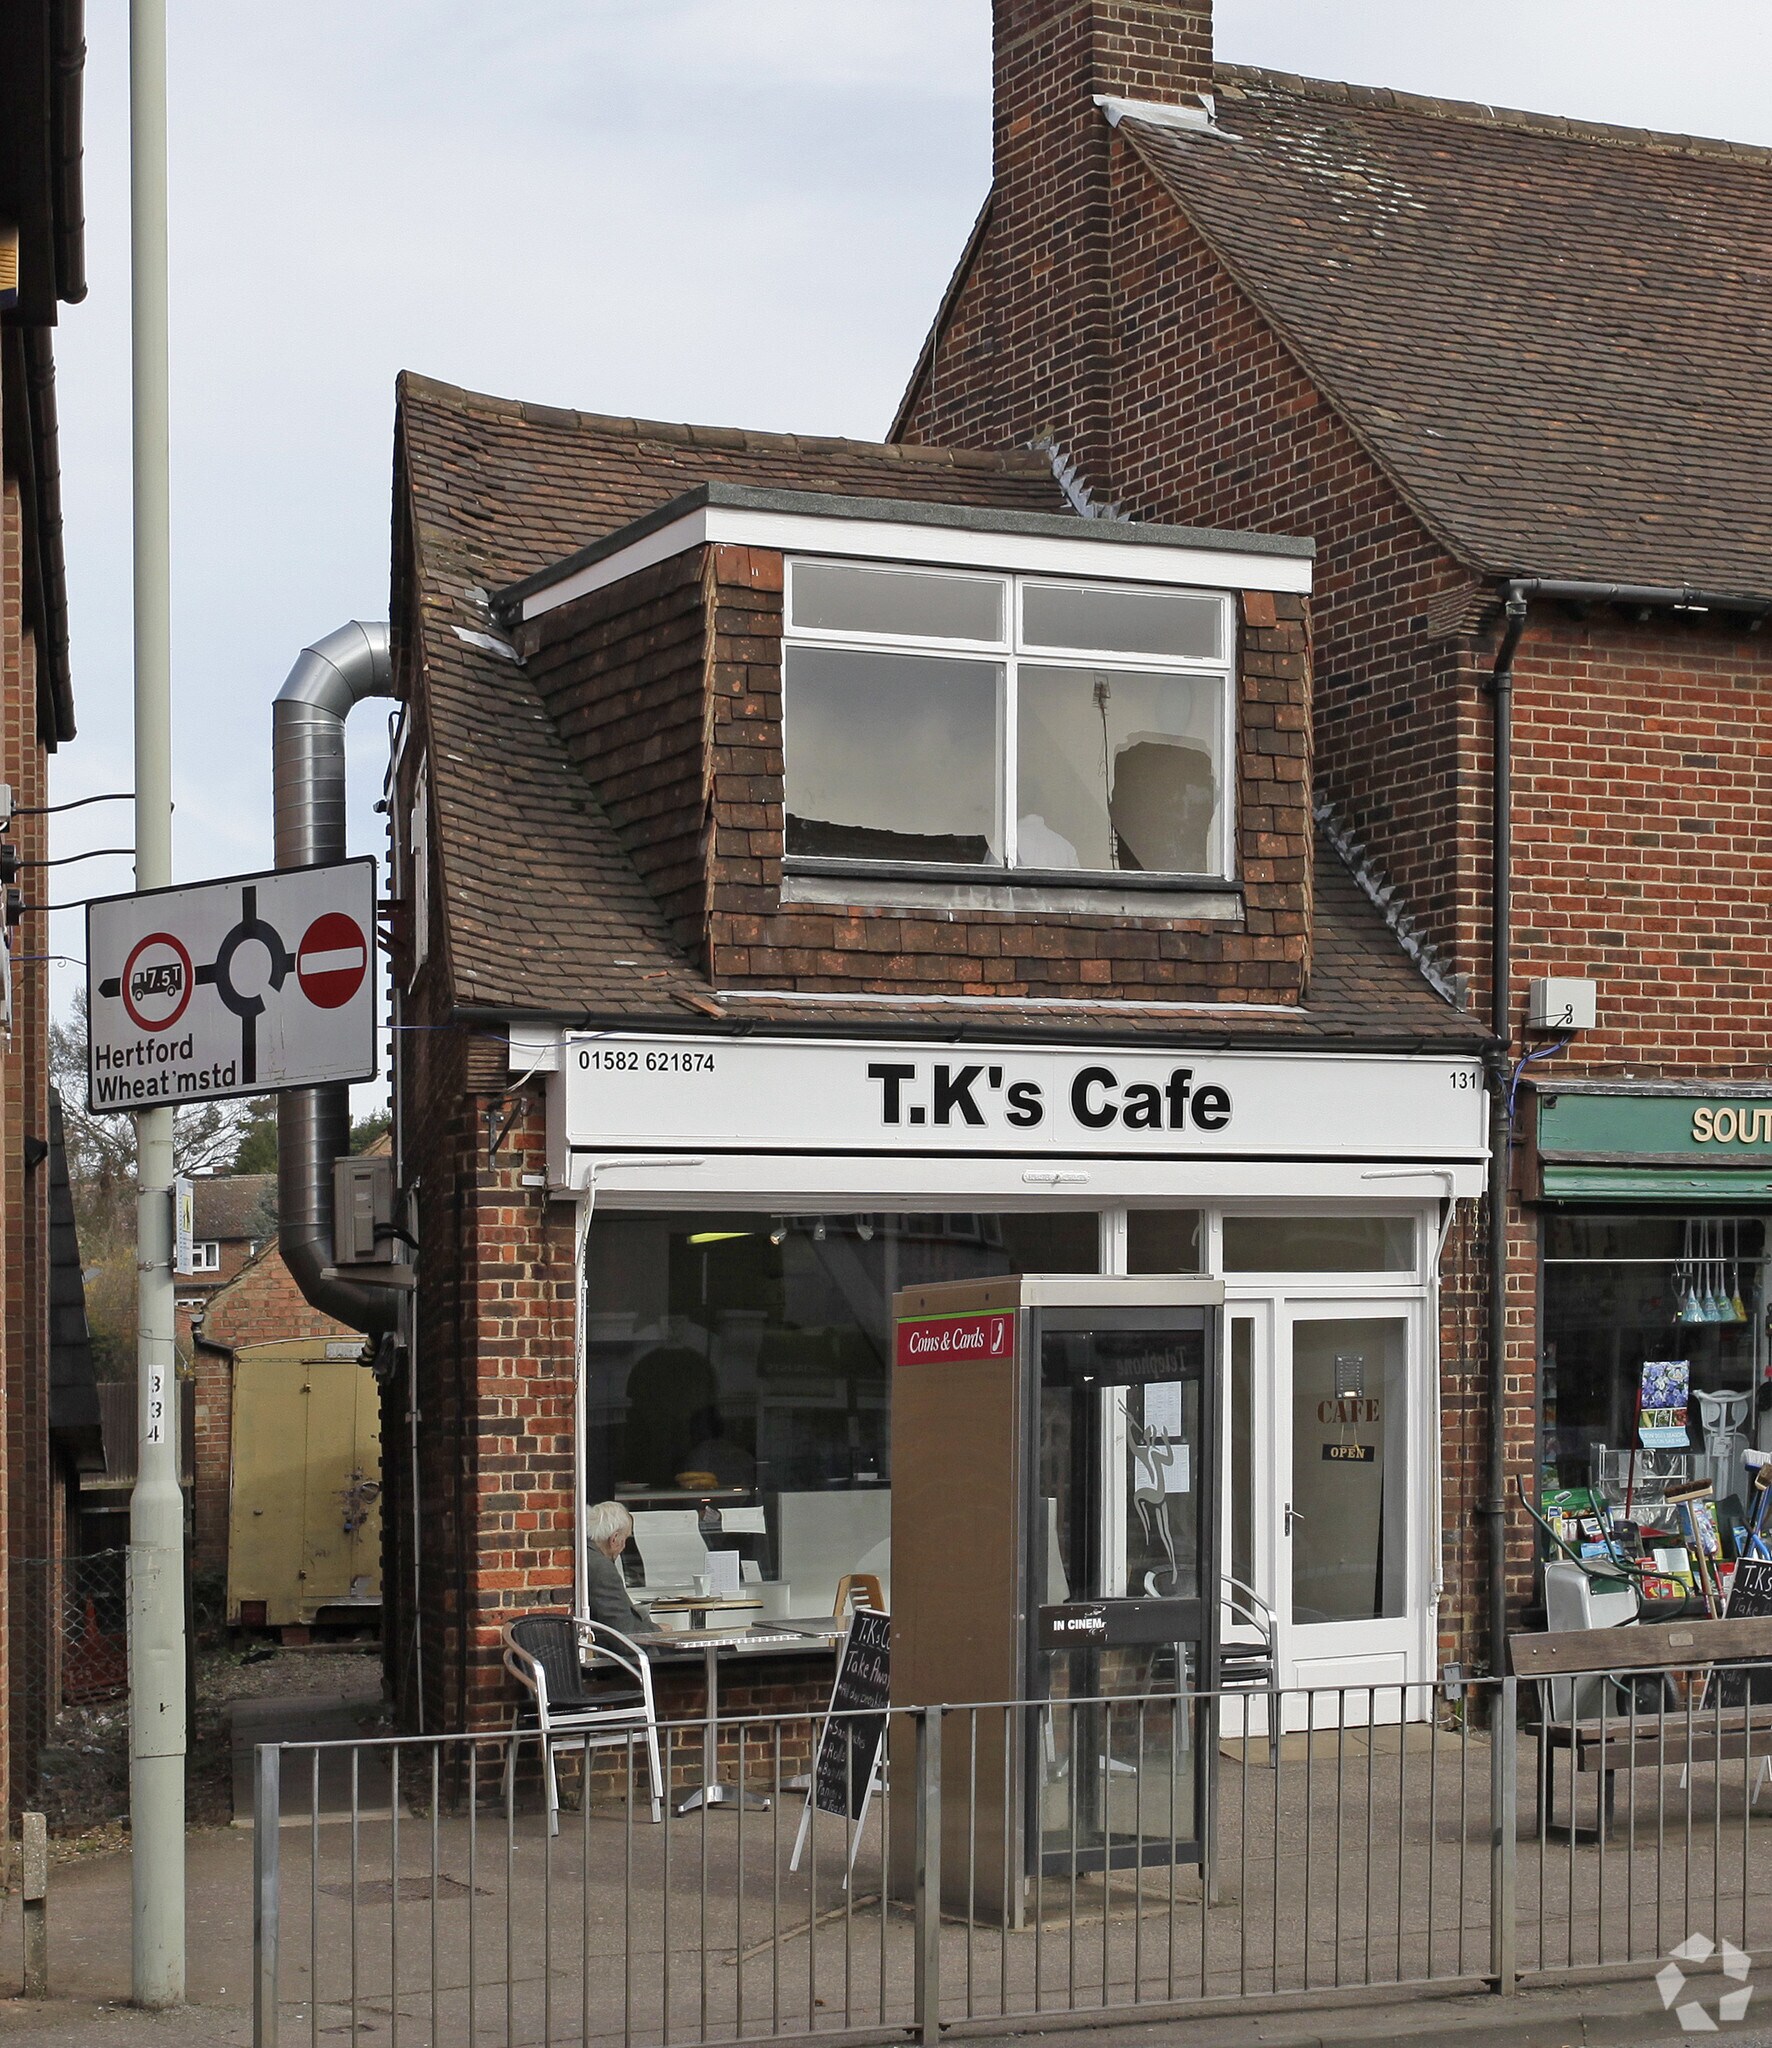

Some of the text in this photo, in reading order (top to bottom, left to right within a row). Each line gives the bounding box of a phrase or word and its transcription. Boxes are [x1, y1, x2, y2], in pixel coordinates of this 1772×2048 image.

[95, 1033, 194, 1071] Hertford
[578, 1050, 716, 1074] 01582 621874
[96, 1060, 237, 1103] Wheat'mstd
[1449, 1071, 1477, 1090] 131
[867, 1062, 1232, 1131] T.K's Cafe
[909, 1326, 985, 1354] Coins & Cards
[1317, 1398, 1381, 1424] CAFE
[1330, 1446, 1366, 1460] OPEN
[1733, 1596, 1759, 1618] Take
[1053, 1617, 1106, 1631] IN CINEM
[846, 1650, 870, 1679] Take
